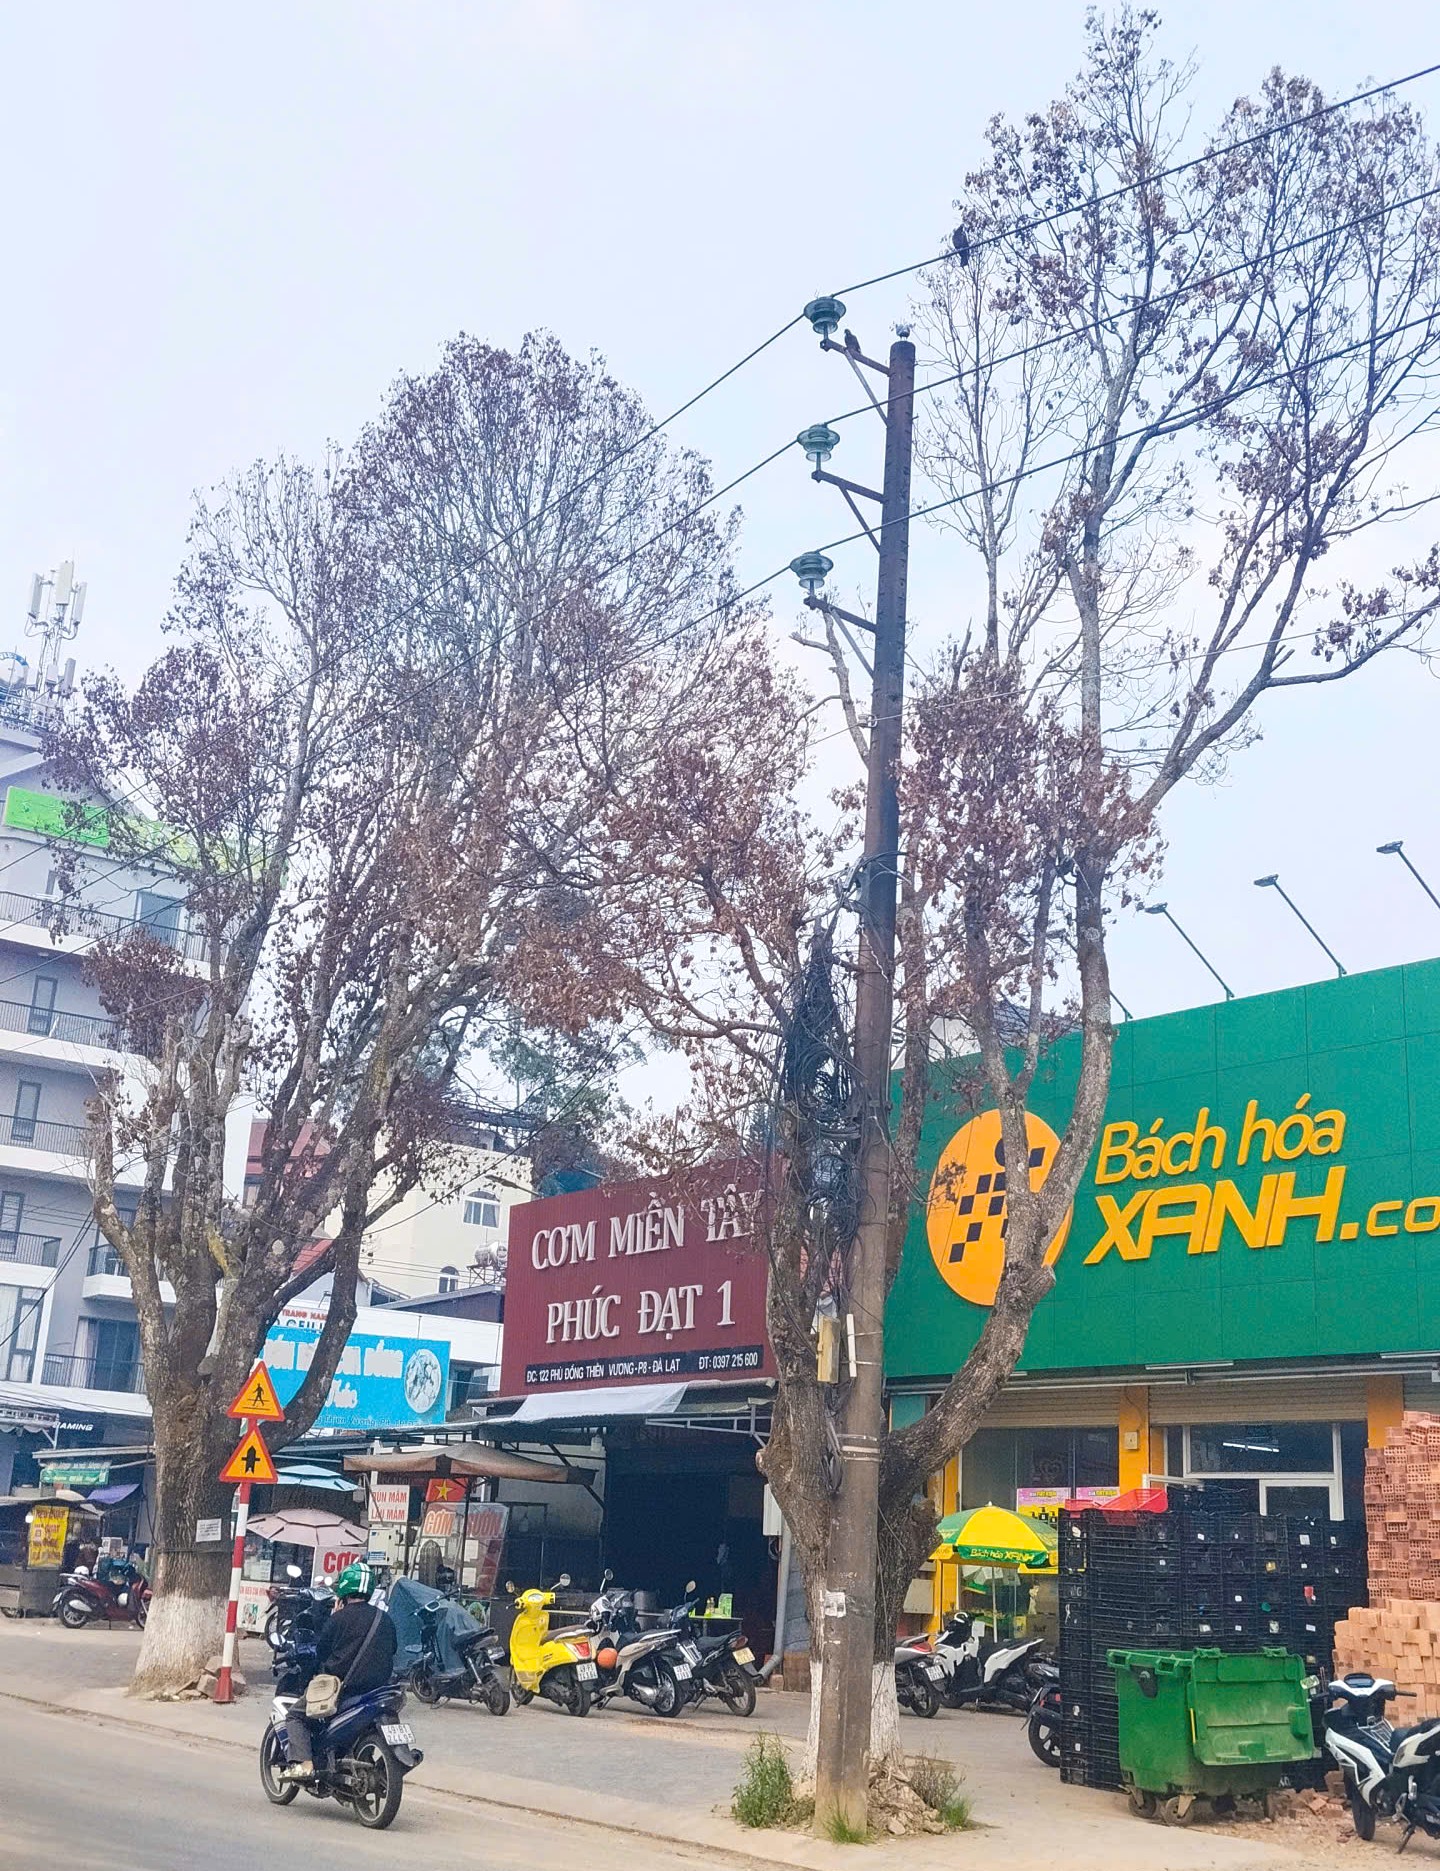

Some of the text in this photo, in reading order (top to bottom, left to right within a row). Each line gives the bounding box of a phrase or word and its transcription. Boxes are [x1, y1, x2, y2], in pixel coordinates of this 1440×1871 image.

[1095, 1092, 1346, 1185] Bách hóa
[532, 1221, 597, 1270] CƠM
[608, 1192, 685, 1258] MIỀN
[546, 1280, 736, 1344] PHÚC ĐẠT 1
[527, 1370, 538, 1382] ĐC:
[539, 1369, 549, 1382] 122
[665, 1358, 681, 1374] LẠT
[698, 1356, 712, 1370] ĐT:
[712, 1354, 731, 1369] 0397
[731, 1353, 744, 1367] 215
[744, 1352, 758, 1367] 600
[1004, 1551, 1035, 1562] XANH
